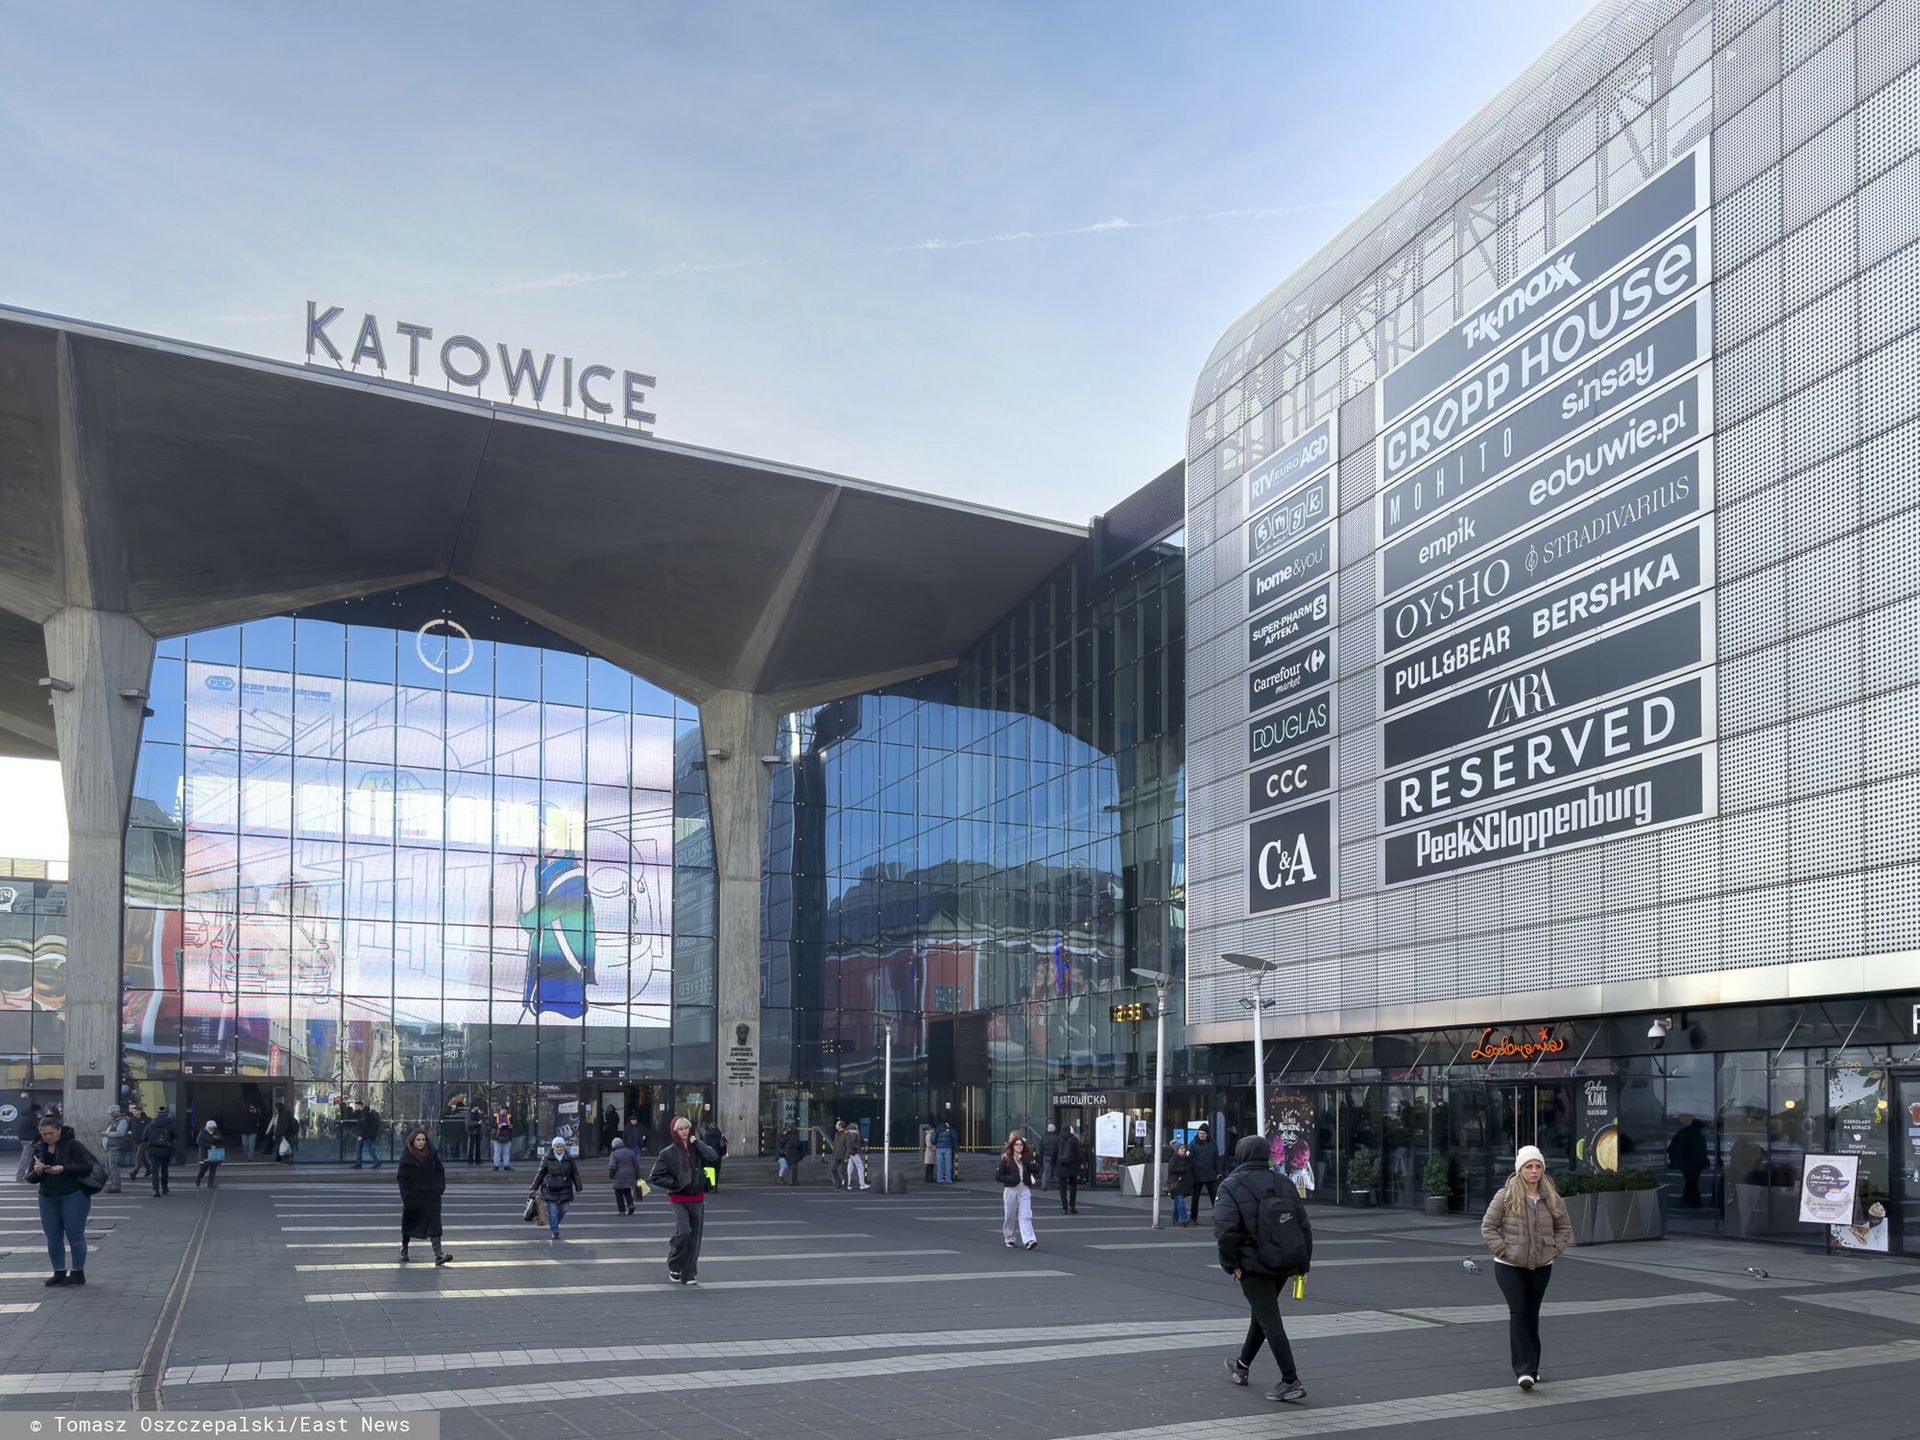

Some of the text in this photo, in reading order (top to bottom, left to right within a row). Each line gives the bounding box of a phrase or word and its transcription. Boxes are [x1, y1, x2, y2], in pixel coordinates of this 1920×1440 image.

[306, 300, 656, 424] KATOWICE
[1561, 345, 1654, 419] sinsay
[1387, 362, 1510, 472] CROPP
[1252, 434, 1329, 500] RTV EURO AGD
[1390, 427, 1512, 526] MOHITO
[1528, 400, 1686, 505] eobuwie.pl
[1256, 490, 1322, 545] smyk
[1419, 515, 1476, 564] empik
[1542, 476, 1689, 564] STRADIVARIUS
[1256, 546, 1324, 595] home&you
[1395, 559, 1510, 638] OYSHO
[1532, 553, 1680, 639] BERSHKA
[1253, 602, 1313, 641] SUPER-PHARM
[1264, 622, 1299, 646] APTEKA
[1253, 662, 1301, 693] Carrefour
[1275, 676, 1301, 695] market
[1395, 625, 1511, 696] PULL&BEAR
[1253, 703, 1327, 752] DOUGLAS
[1487, 668, 1559, 729] ZARA
[1266, 764, 1308, 798] CCC
[1400, 696, 1676, 817] RESERVED
[1416, 780, 1652, 867] Peek&Cloppenburg
[1258, 833, 1317, 890] C&A
[1059, 1095, 1107, 1105] KATOWICKA
[1587, 1092, 1607, 1106] KAWA
